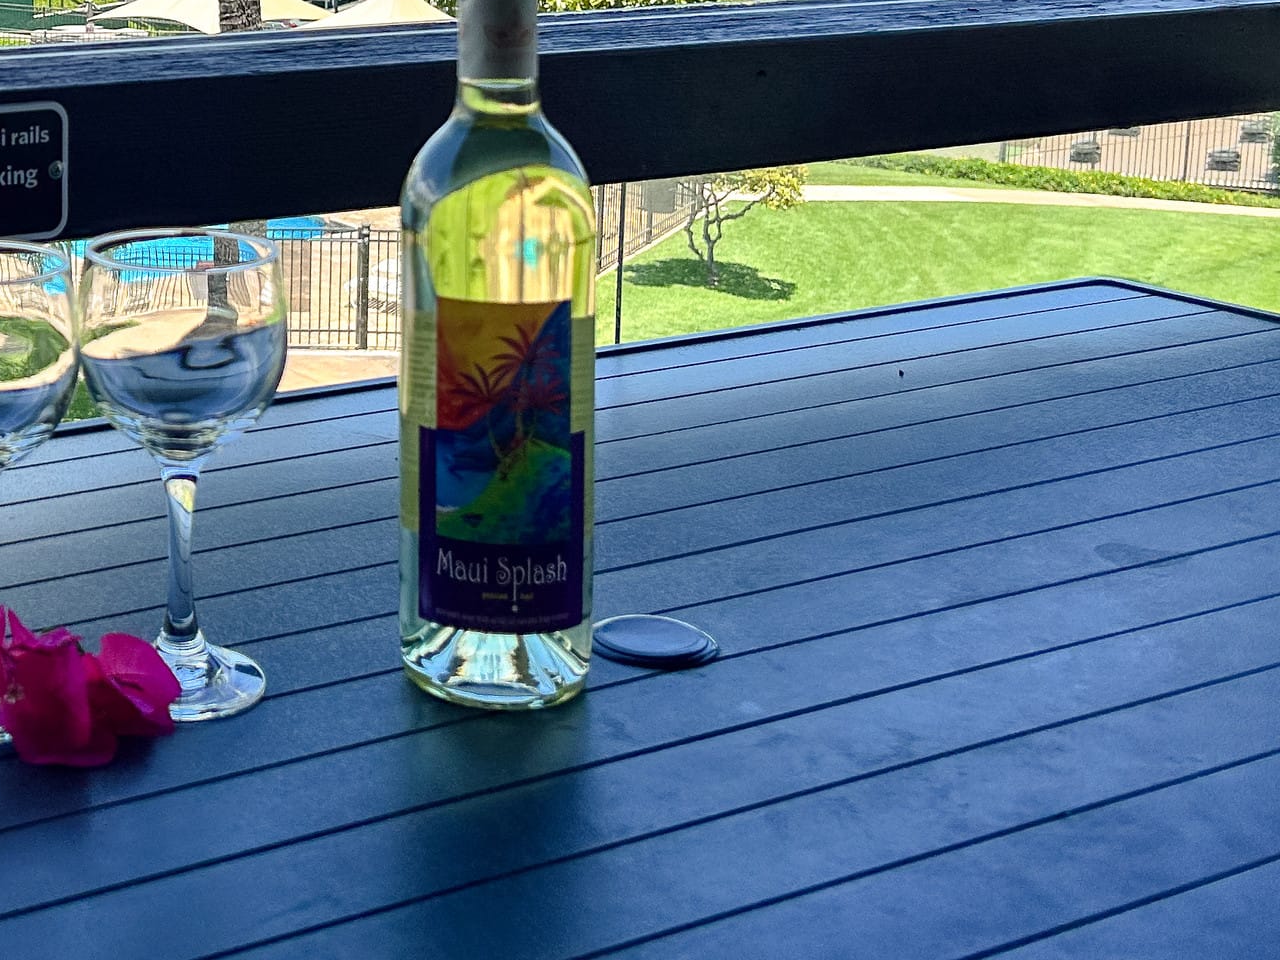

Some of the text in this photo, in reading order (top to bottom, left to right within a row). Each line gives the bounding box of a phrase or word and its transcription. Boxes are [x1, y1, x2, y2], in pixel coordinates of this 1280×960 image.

[10, 125, 50, 146] rails
[436, 547, 568, 601] Maui Splash
